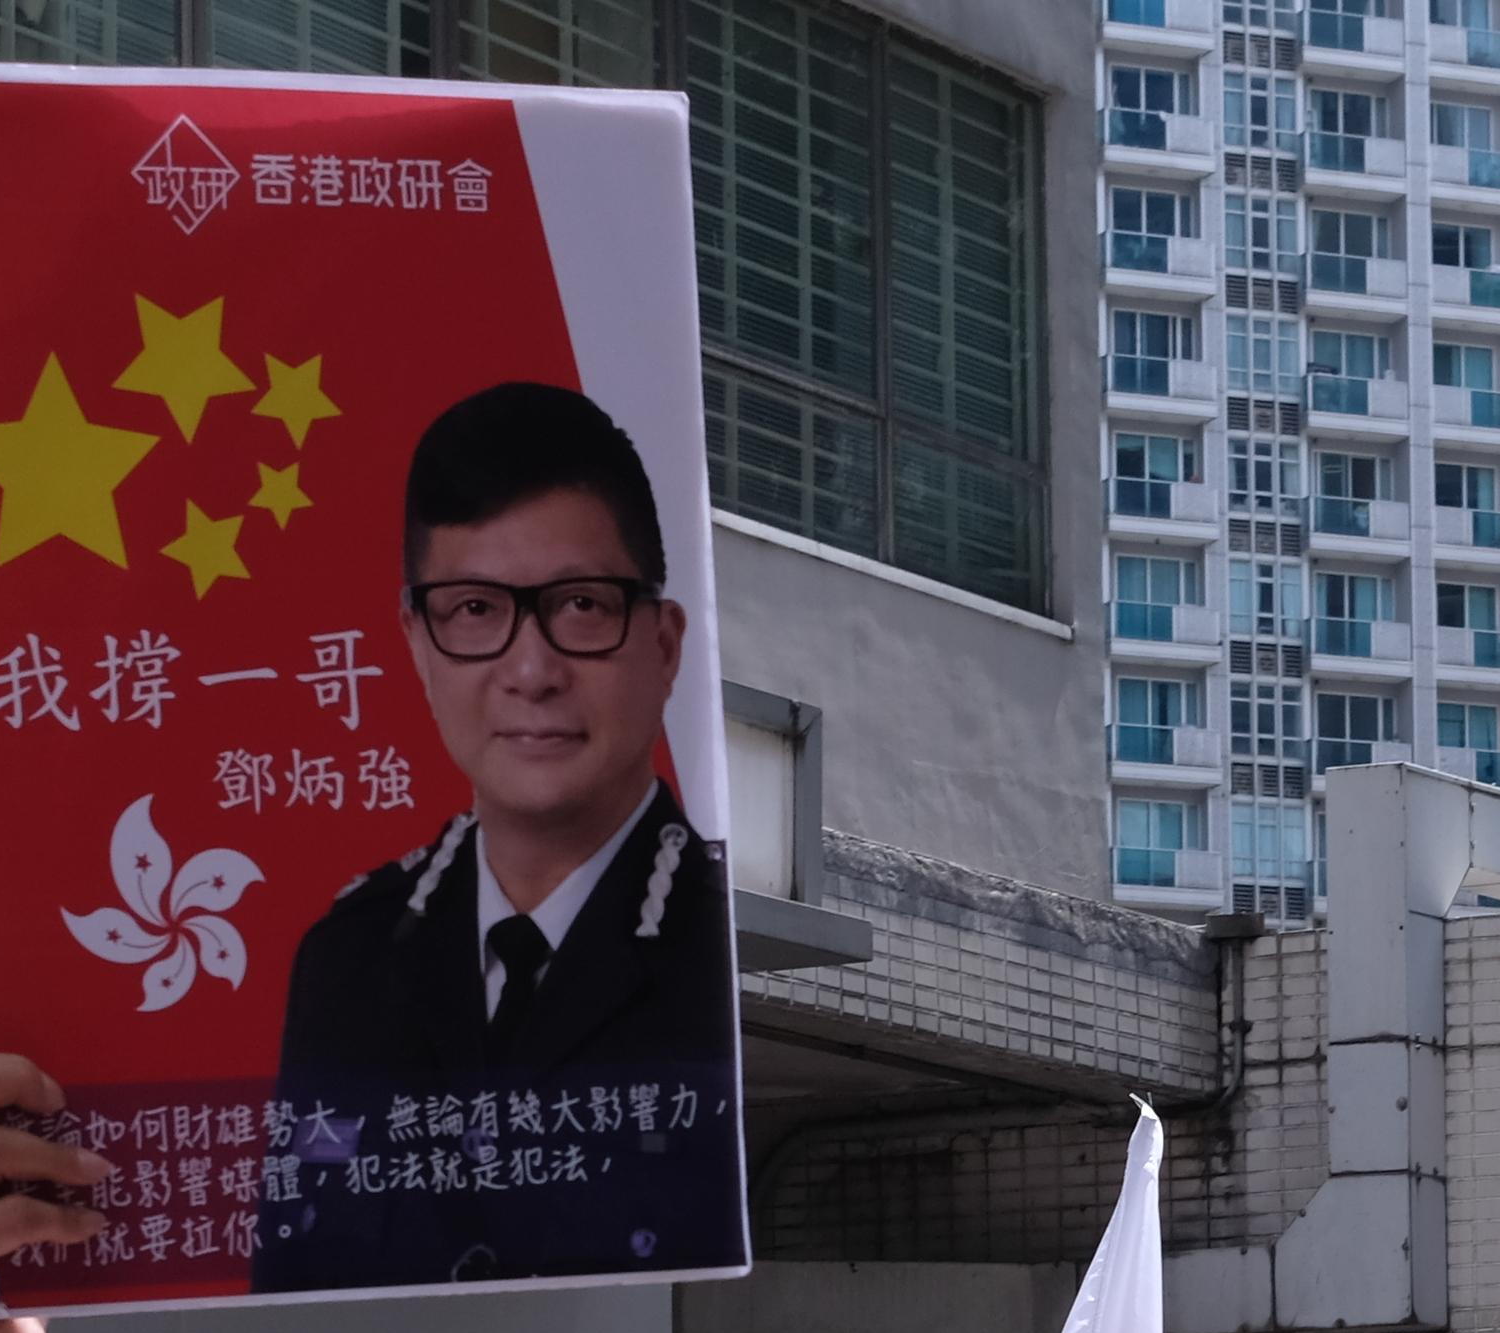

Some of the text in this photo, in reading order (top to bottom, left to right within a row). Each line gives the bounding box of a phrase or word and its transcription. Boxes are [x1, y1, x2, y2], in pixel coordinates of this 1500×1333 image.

[251, 153, 493, 213] 香港政研會
[212, 746, 417, 814] 鄧炳強
